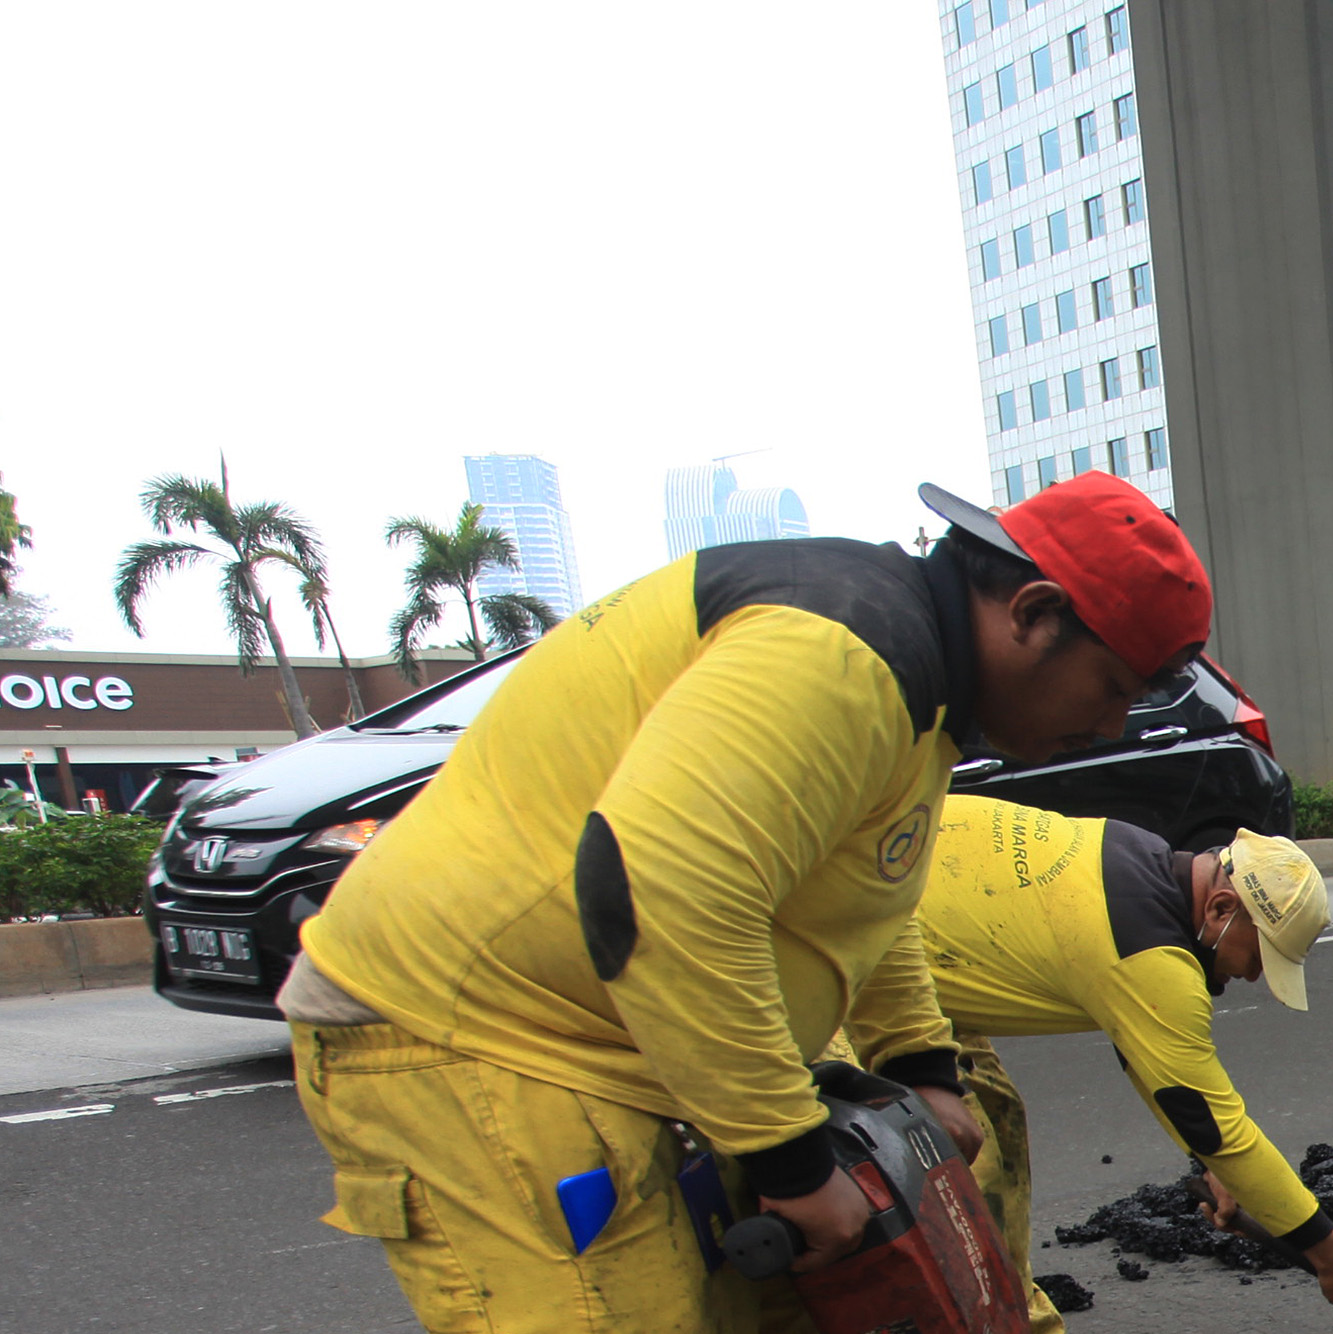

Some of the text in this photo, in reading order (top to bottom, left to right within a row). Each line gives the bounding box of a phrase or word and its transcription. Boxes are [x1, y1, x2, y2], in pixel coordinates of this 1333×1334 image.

[992, 809, 1004, 854] JAKARTA
[1011, 823, 1032, 888] MARGA
[165, 926, 179, 953] B
